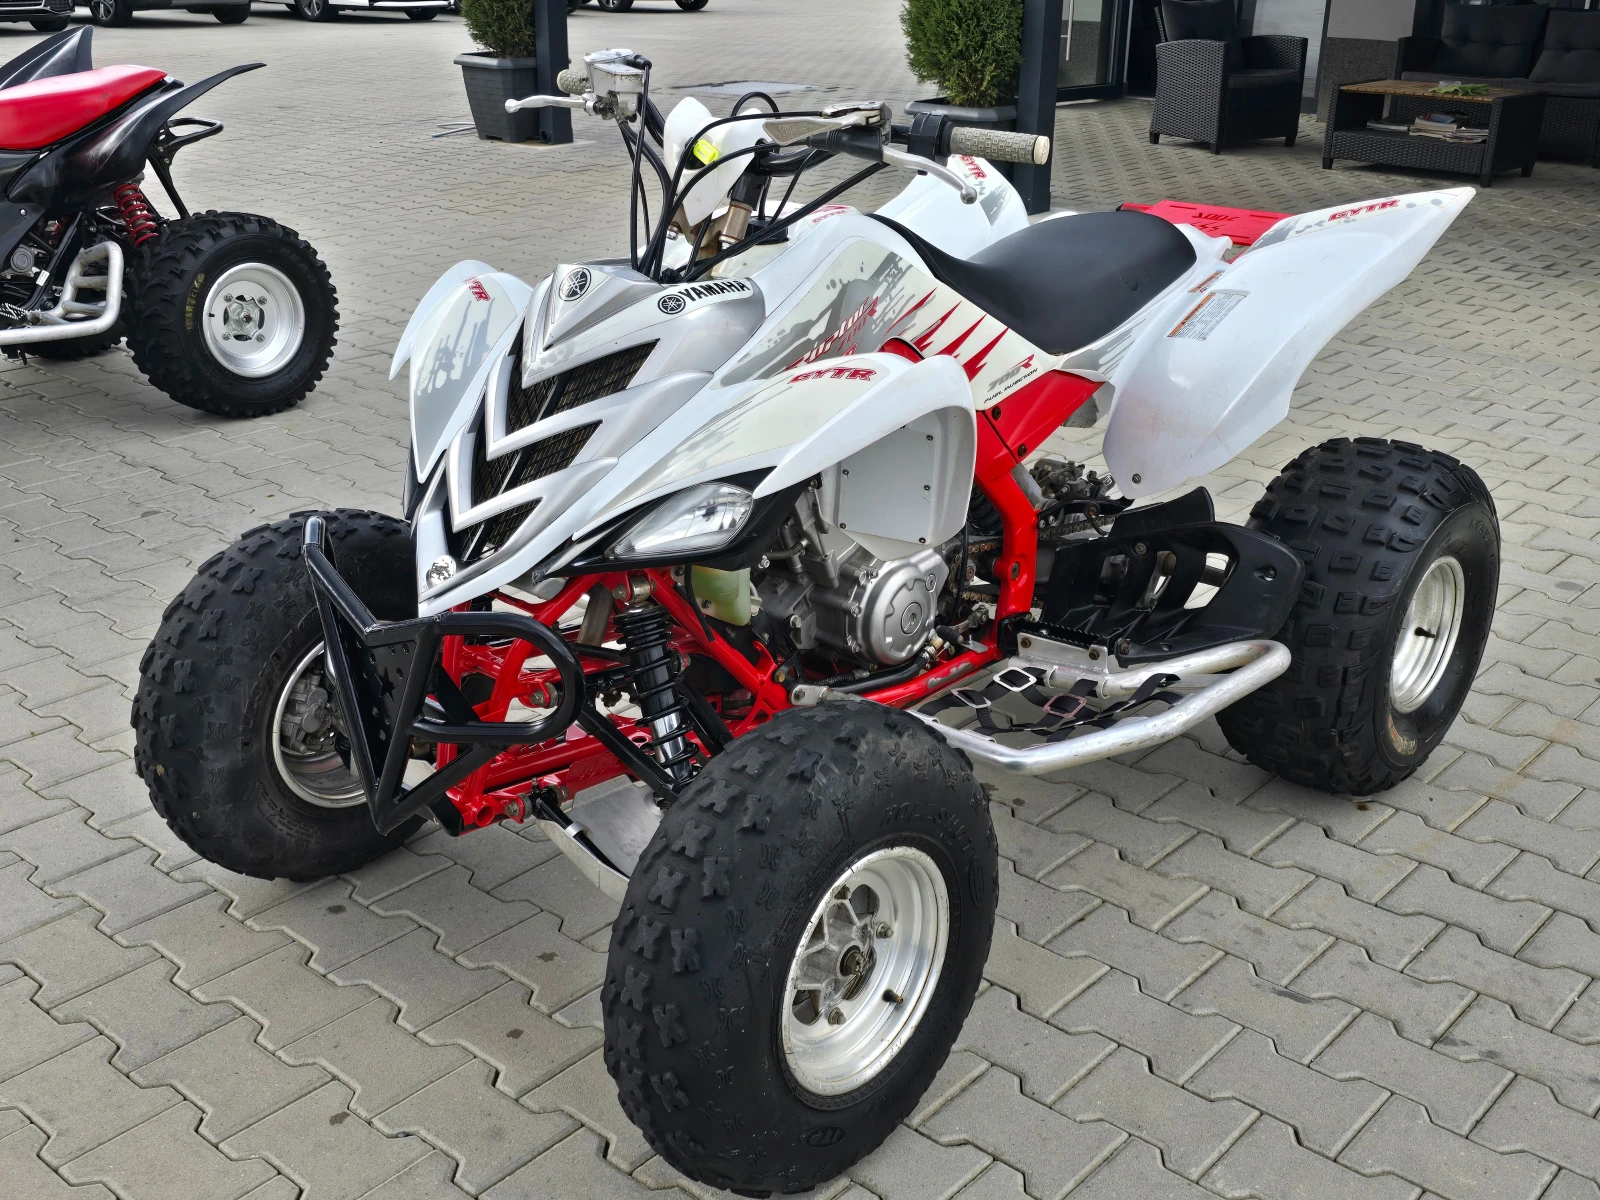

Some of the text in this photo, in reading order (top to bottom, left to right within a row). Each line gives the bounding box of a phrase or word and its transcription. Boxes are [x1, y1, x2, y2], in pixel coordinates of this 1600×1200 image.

[959, 155, 988, 181] GYTR
[1328, 199, 1400, 223] GYTR
[677, 279, 753, 302] YAMAHA
[787, 366, 878, 385] GYTR
[987, 353, 1035, 393] 700R
[983, 367, 1039, 405] FUEL INJECTION
